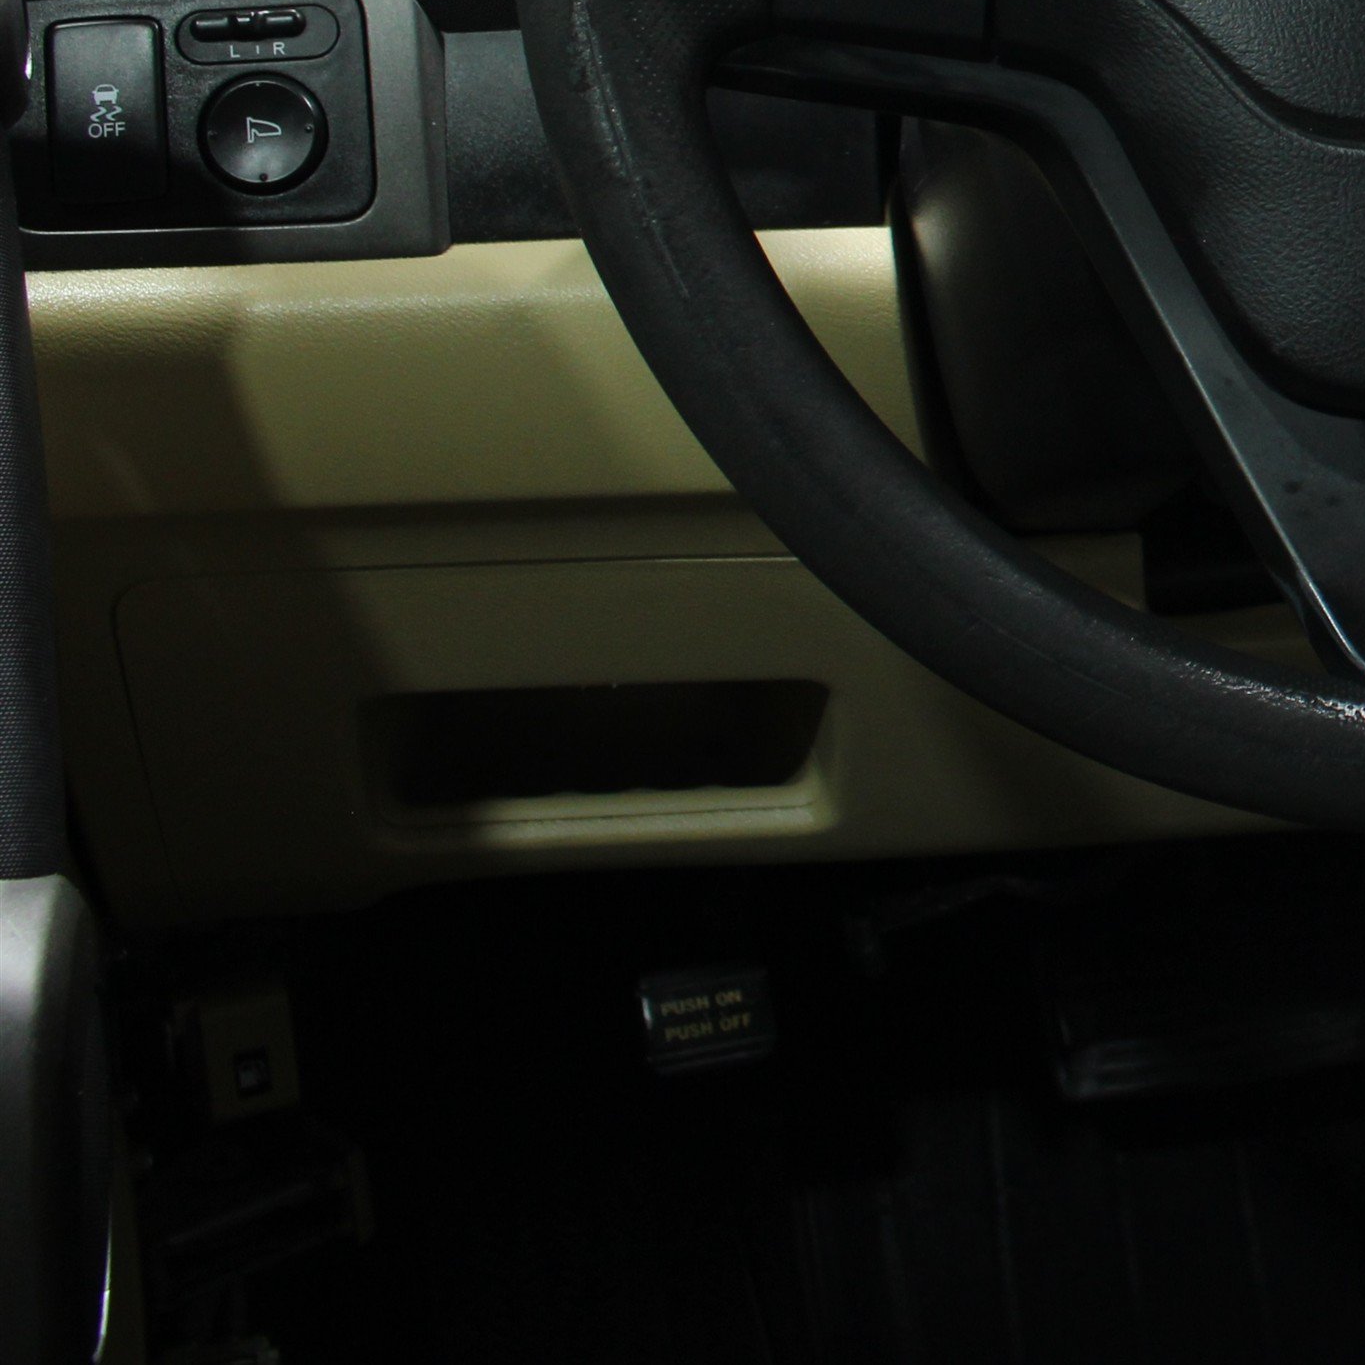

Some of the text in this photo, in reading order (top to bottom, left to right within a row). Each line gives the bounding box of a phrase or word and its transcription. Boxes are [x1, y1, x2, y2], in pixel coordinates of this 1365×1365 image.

[229, 41, 286, 59] L R
[88, 121, 126, 139] OFF
[660, 989, 744, 1017] PUSH ON
[664, 1012, 752, 1042] PUSH OFF
